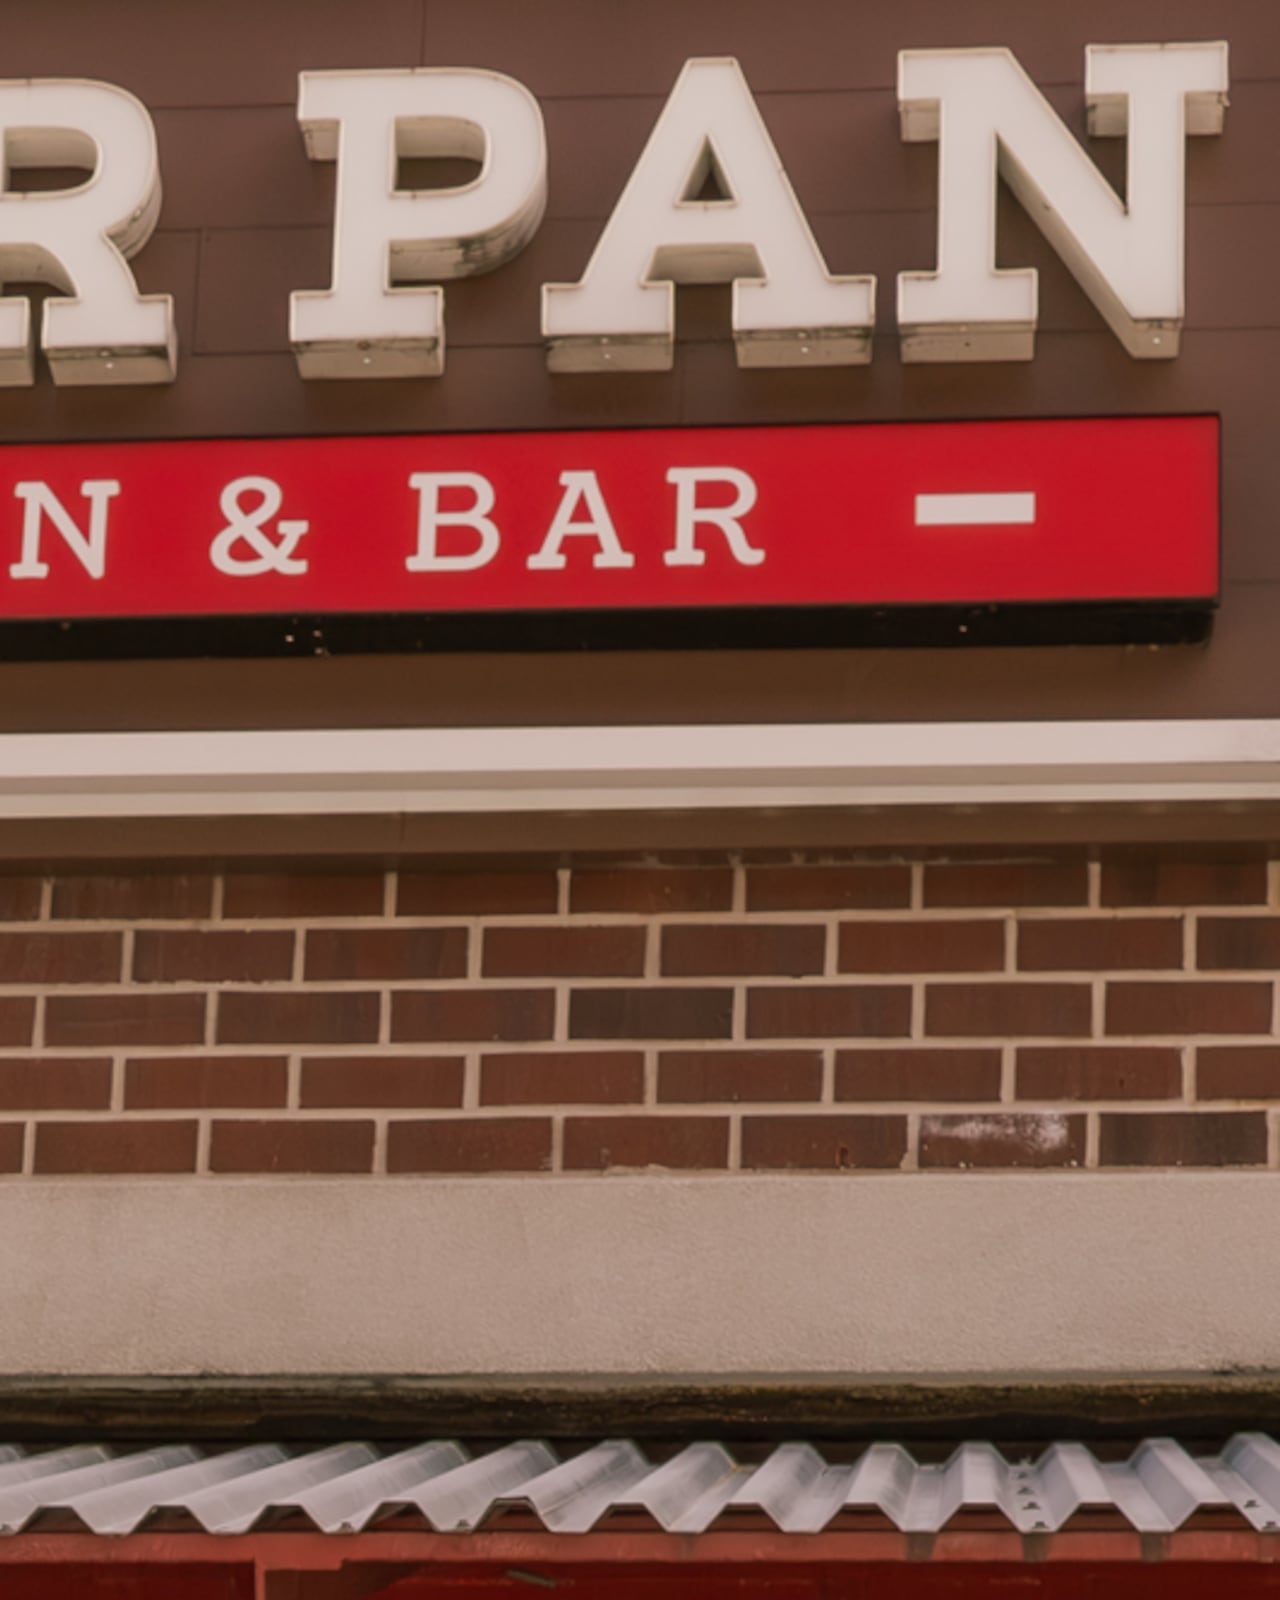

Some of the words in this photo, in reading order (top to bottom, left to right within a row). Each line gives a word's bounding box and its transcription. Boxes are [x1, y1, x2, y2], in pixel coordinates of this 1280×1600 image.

[288, 40, 1230, 379] PAN
[208, 474, 311, 577] &
[405, 465, 765, 574] BAR
